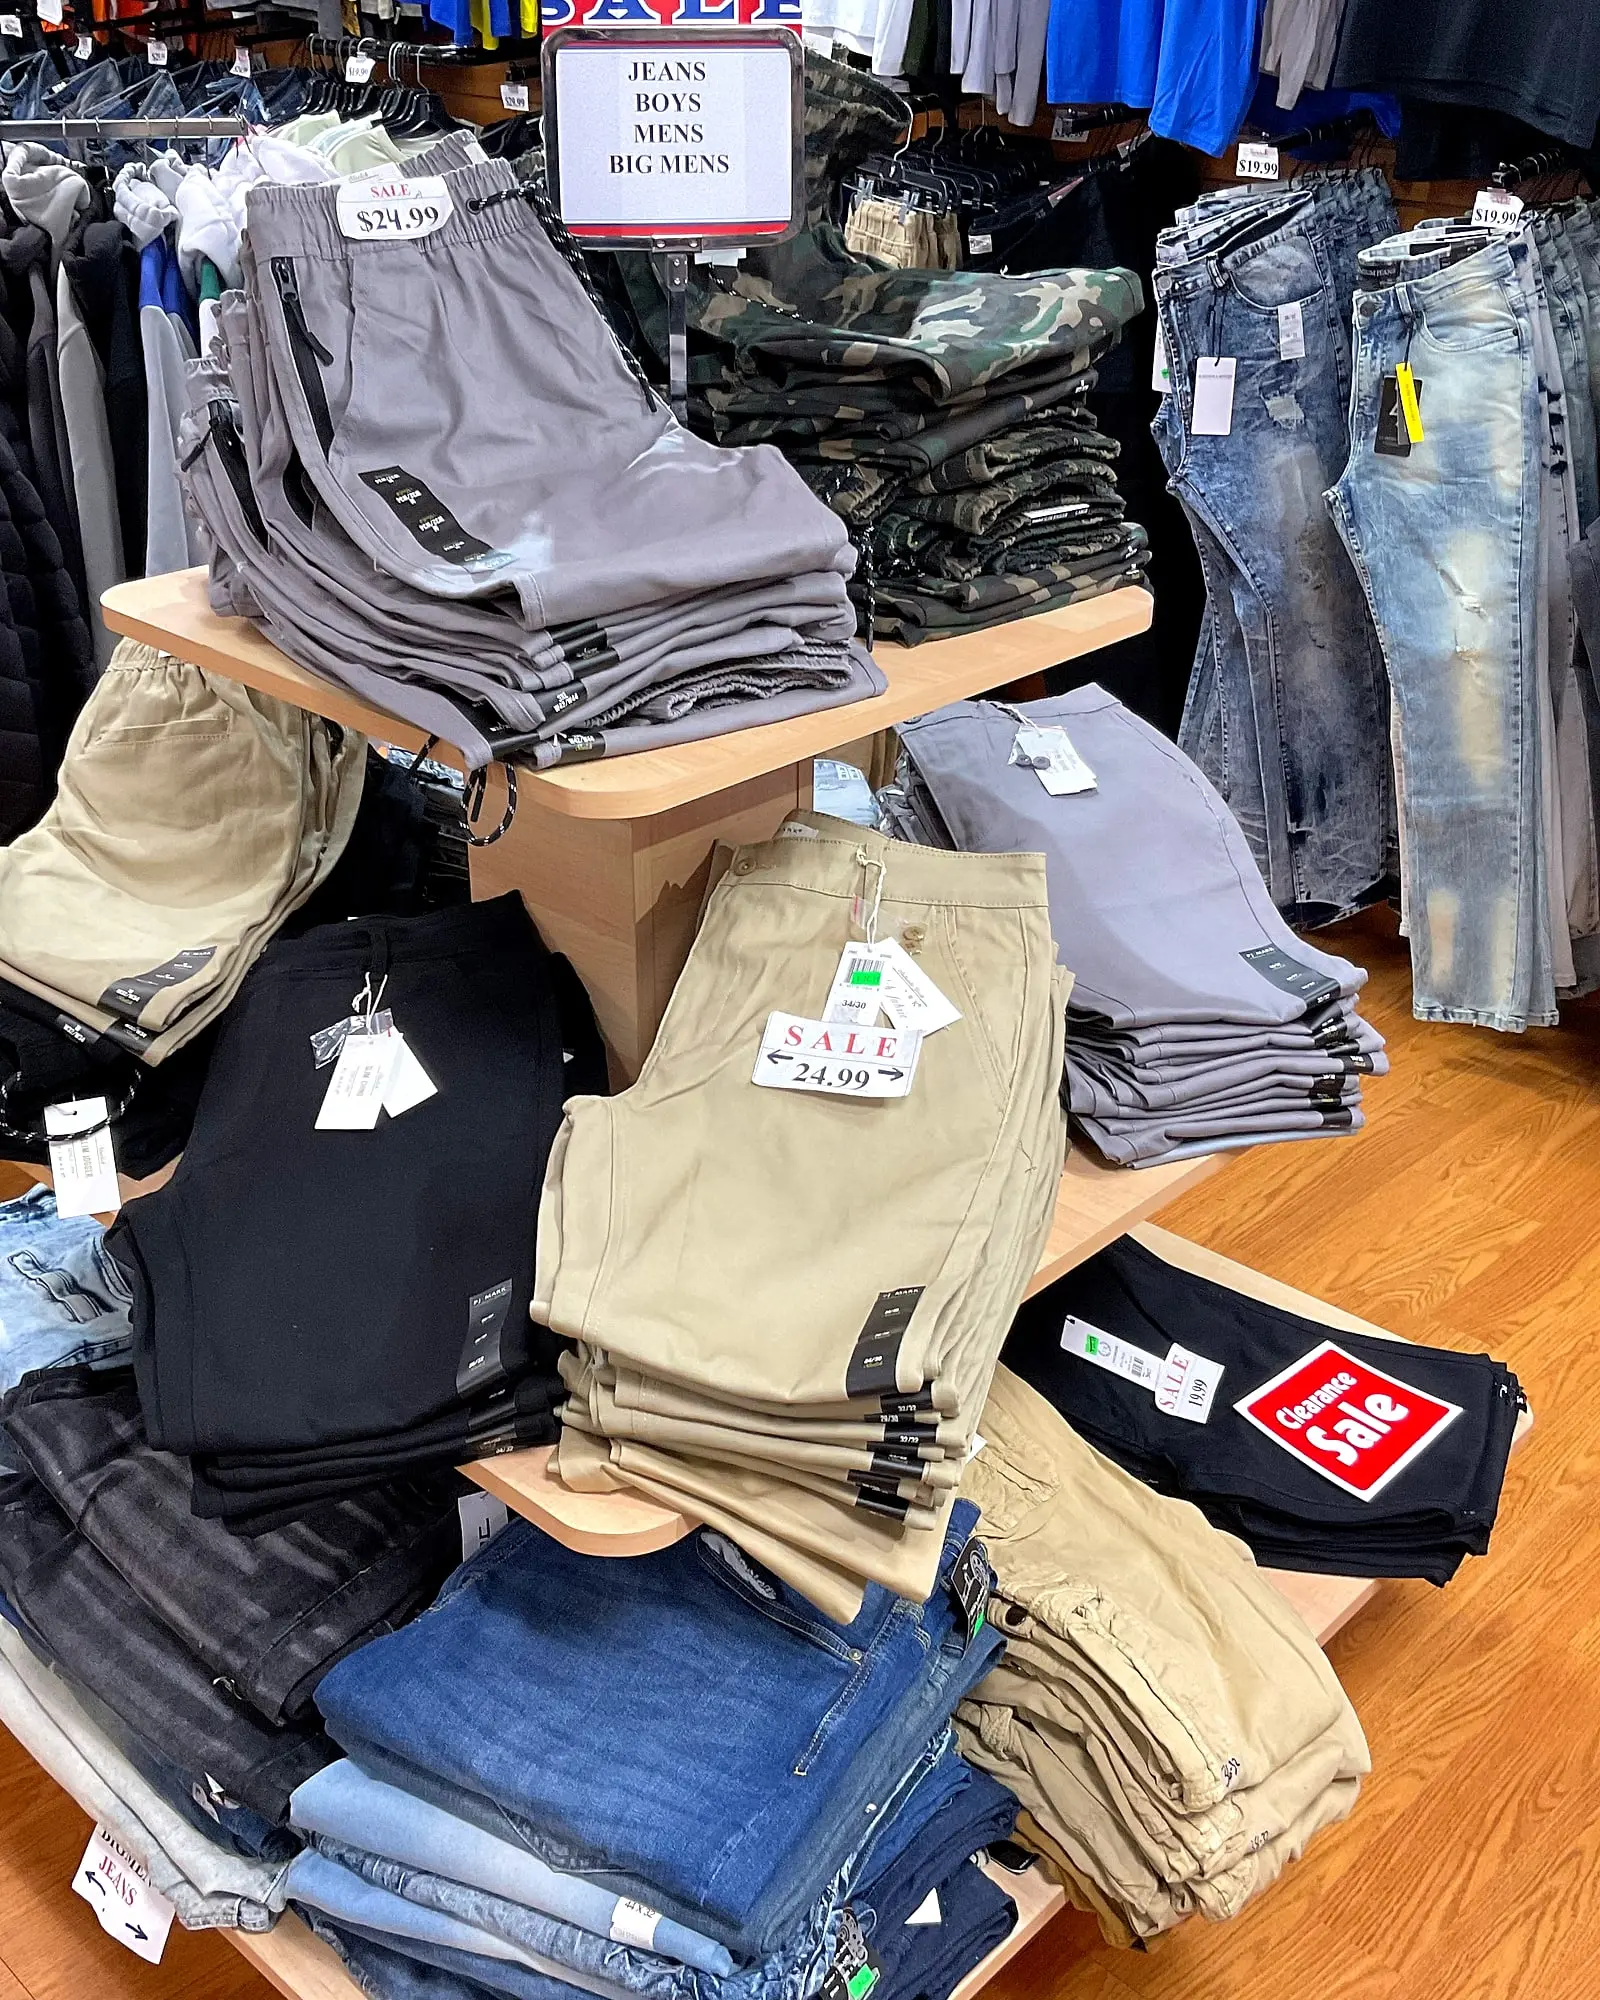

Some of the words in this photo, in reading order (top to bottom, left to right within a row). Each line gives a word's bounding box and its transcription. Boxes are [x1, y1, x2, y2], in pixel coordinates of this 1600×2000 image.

[628, 61, 706, 81] JEANS
[635, 92, 701, 113] BOYS
[634, 124, 704, 144] MENS
[609, 154, 652, 175] BIG
[660, 154, 730, 174] MENS
[1238, 159, 1278, 175] $19.99
[370, 183, 411, 198] SALE
[356, 206, 439, 233] $24.99
[1474, 208, 1517, 226] $19.99
[841, 999, 867, 1010] 34/30
[784, 1024, 898, 1059] SALE
[792, 1063, 870, 1091] 24.99
[484, 1286, 507, 1300] MARK
[1158, 1354, 1190, 1410] SALE
[1188, 1379, 1208, 1407] 19.99
[1275, 1371, 1358, 1430] Clearance
[1305, 1393, 1409, 1468] Sale
[98, 1855, 138, 1906] JEANS
